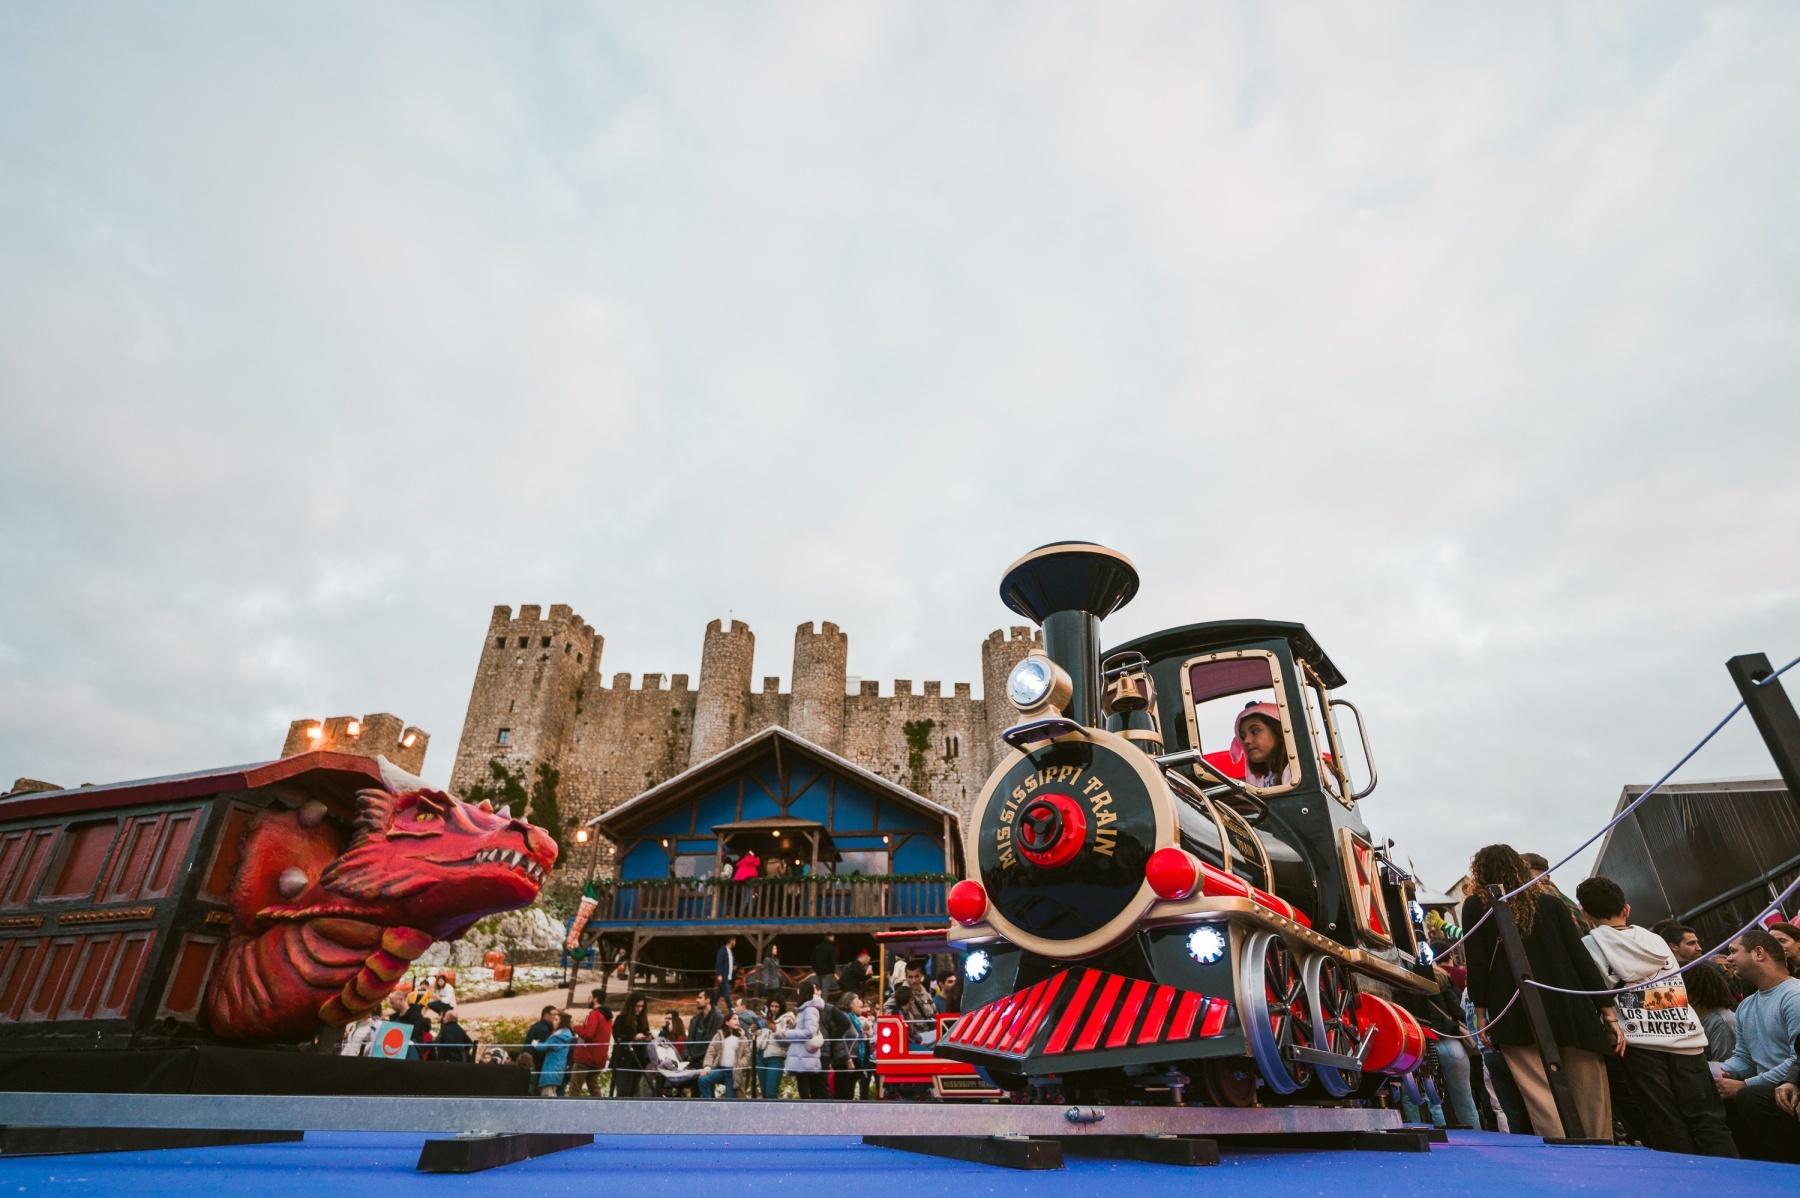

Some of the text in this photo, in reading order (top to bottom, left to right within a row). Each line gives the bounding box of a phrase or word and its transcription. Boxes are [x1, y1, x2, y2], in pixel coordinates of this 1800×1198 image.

[997, 765, 1117, 870] MISSISSIPPI TRAIN
[1621, 1009, 1643, 1021] LOS
[1640, 1021, 1686, 1035] LAKERS
